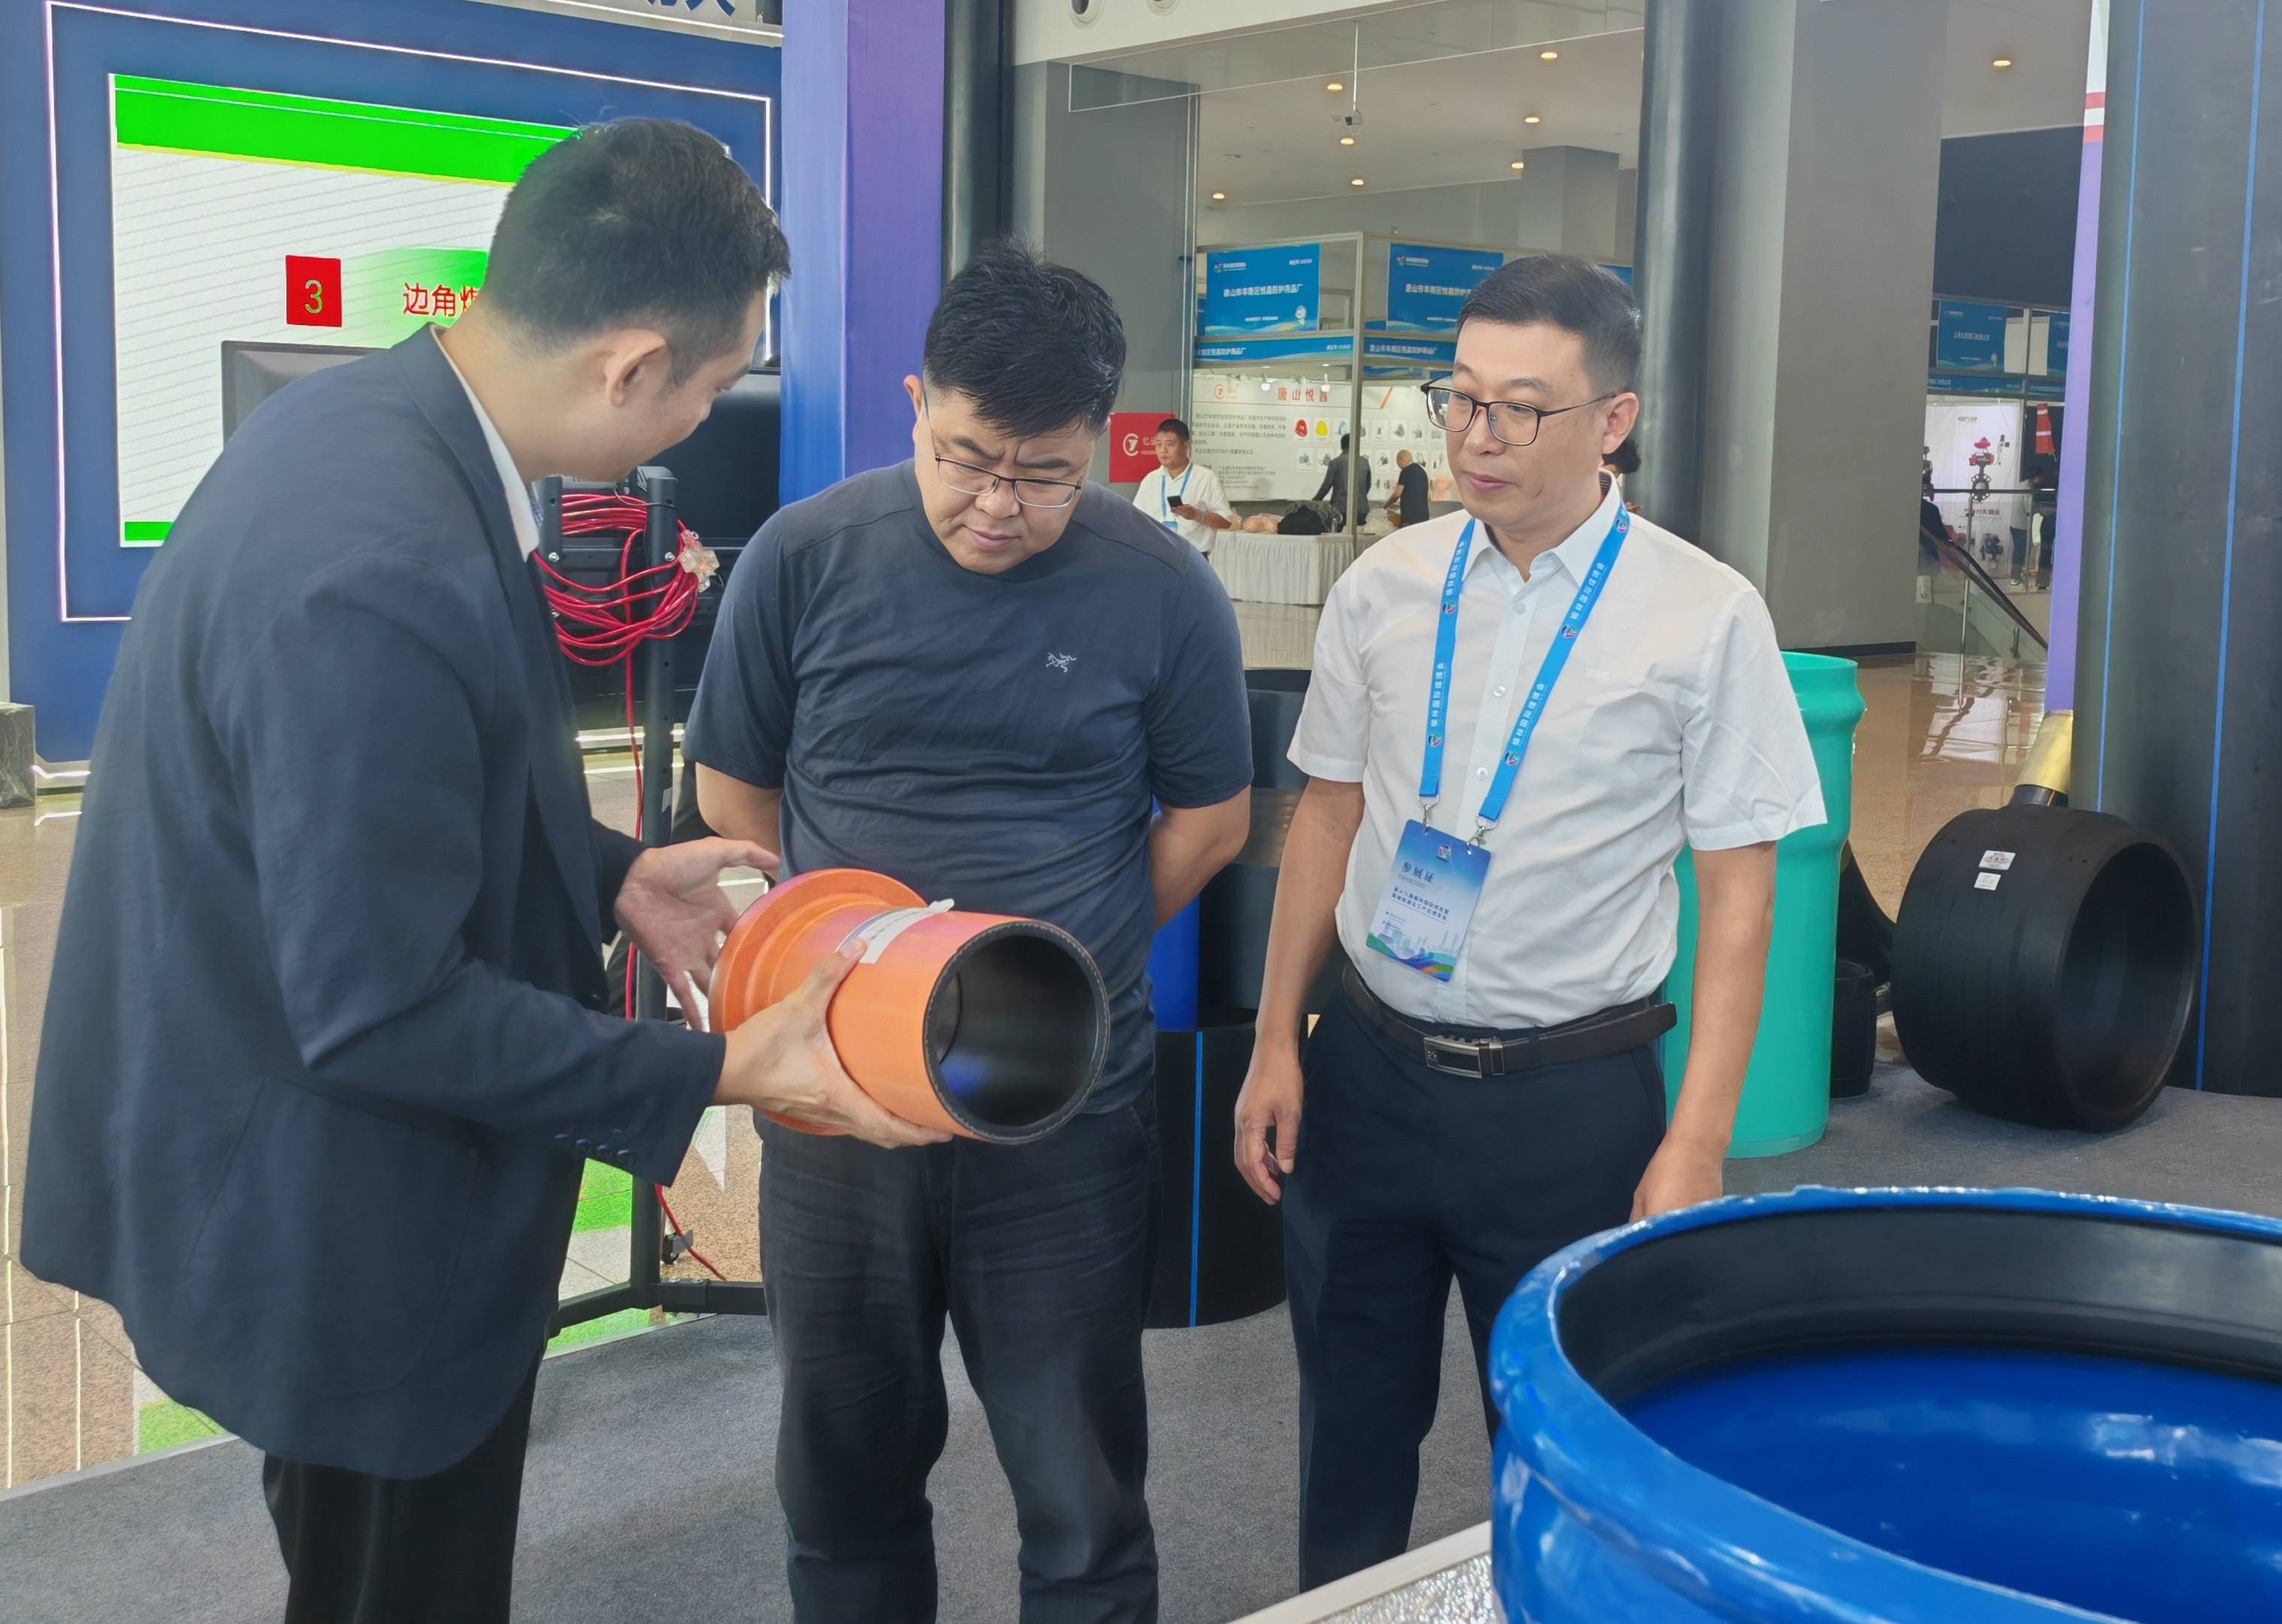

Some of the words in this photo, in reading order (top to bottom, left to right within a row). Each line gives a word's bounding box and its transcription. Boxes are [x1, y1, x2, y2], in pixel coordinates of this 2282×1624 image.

[304, 278, 323, 314] 3
[1402, 861, 1436, 884] 参展证
